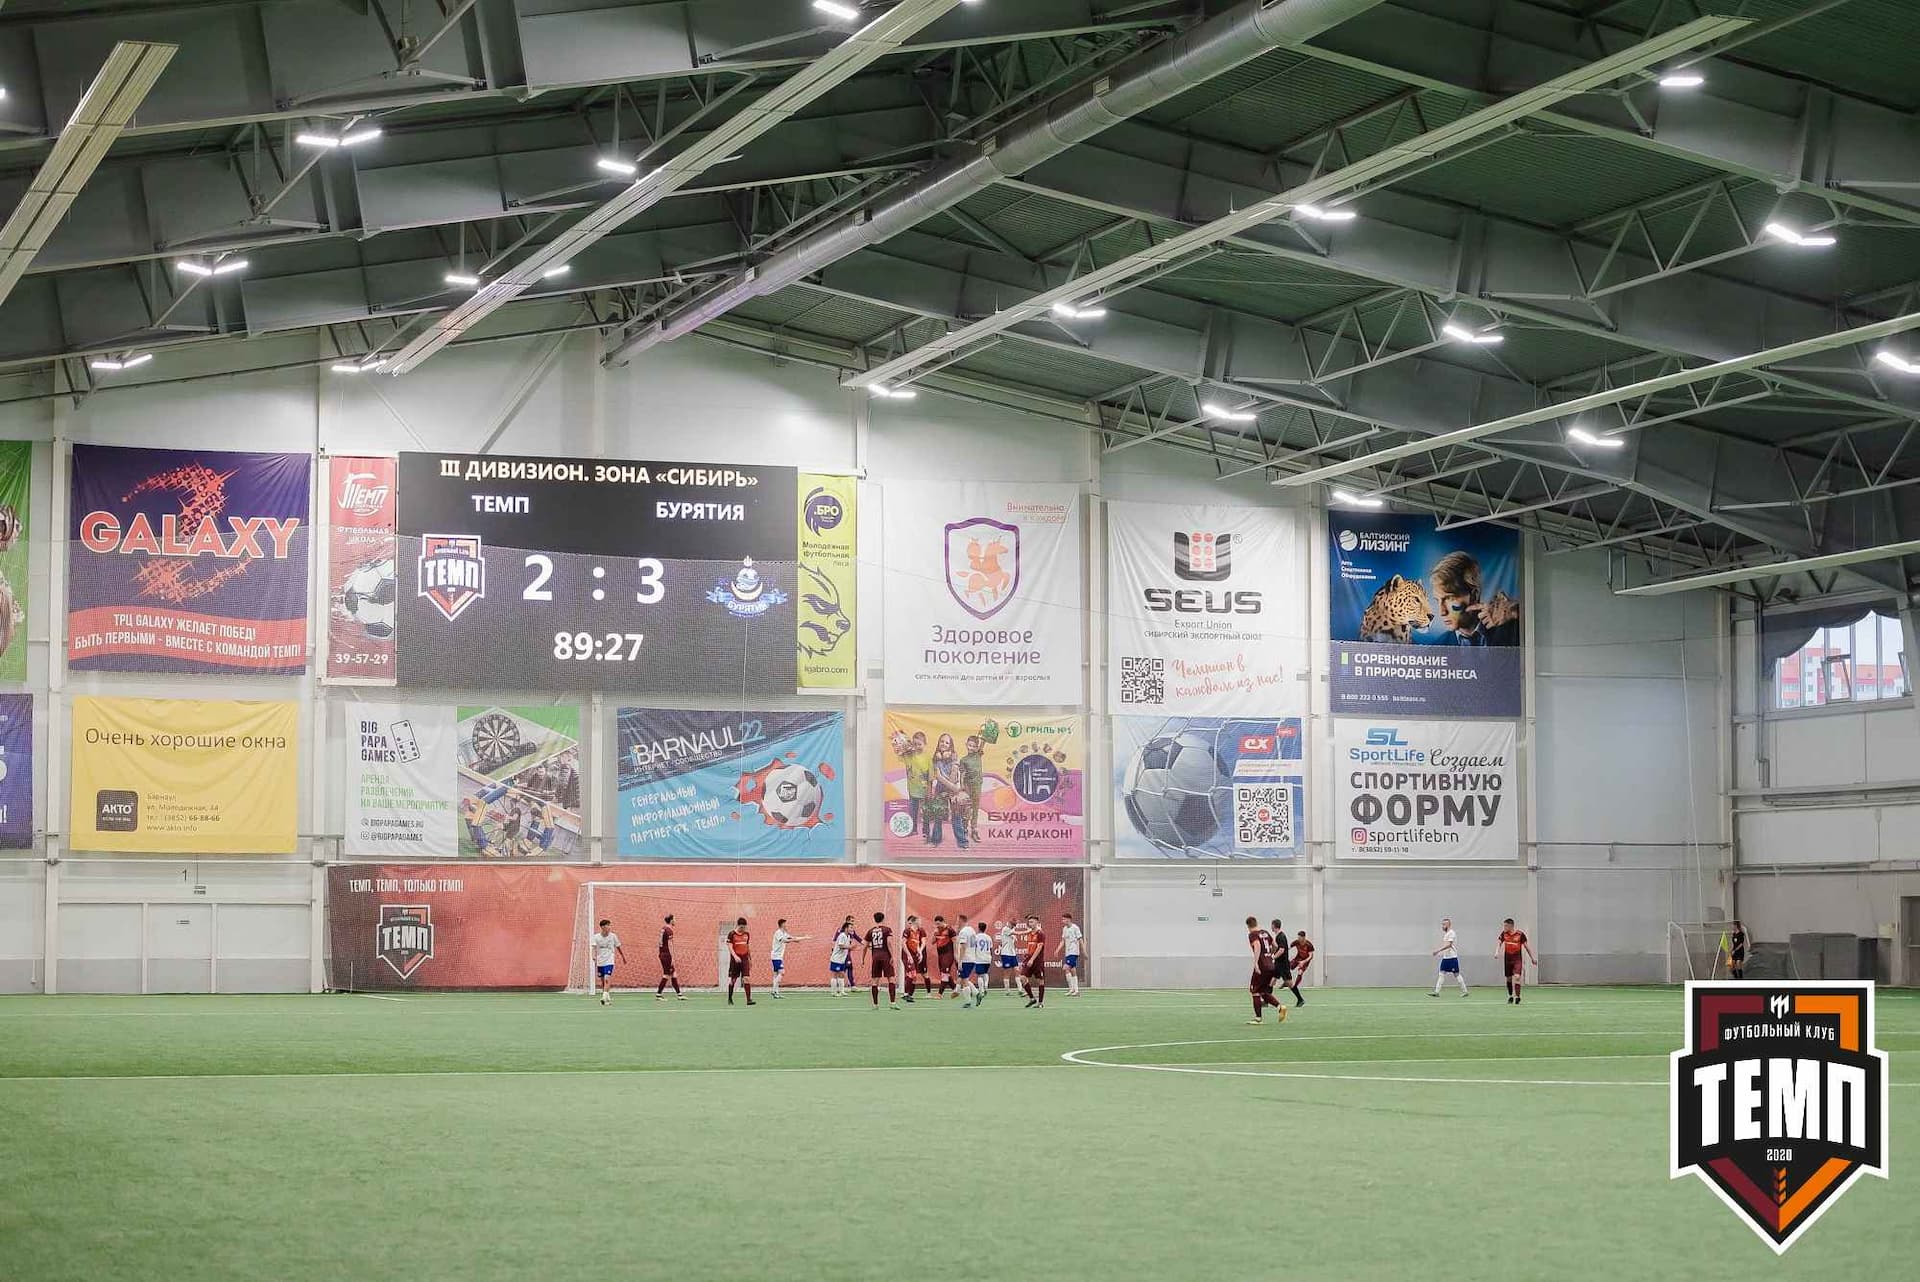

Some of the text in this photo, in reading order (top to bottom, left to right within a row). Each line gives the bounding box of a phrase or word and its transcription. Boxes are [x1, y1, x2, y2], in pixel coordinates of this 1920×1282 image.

[465, 461, 589, 482] ДИВИЗИОН.
[594, 466, 650, 484] ЗОНА
[655, 468, 758, 488] «СИБИРЬ»
[472, 494, 529, 513] ТЕМП
[655, 501, 744, 521] БУРЯТИЯ
[80, 510, 300, 559] GALAXY
[1359, 531, 1410, 541] БАЛТИЙСКИЙ
[1359, 540, 1410, 552] ЛИЗИНГ
[425, 559, 479, 588] ТЕМП
[522, 555, 553, 600] 2
[636, 558, 665, 604] 3
[1143, 588, 1263, 615] SEUS
[113, 613, 133, 626] ТРЦ
[136, 614, 174, 629] GALAXY
[176, 618, 217, 636] ЖЕЛАЕТ
[1174, 619, 1233, 630] Export Union
[931, 625, 1033, 645] Здоровое
[74, 633, 103, 650] БЫТЬ
[105, 631, 156, 645] ПЕРВЫМИ
[165, 634, 205, 653] ВМЕСТЕ
[215, 642, 270, 659] КОМАНДОЙ
[553, 631, 644, 662] 89:27
[335, 653, 389, 665] 39-57-29
[924, 649, 1041, 665] поколение
[1354, 653, 1448, 667] СОРЕВНОВАНИЕ
[1354, 666, 1478, 681] В ПРИРОДЕ БИЗНЕСА
[361, 720, 378, 734] BIG
[85, 727, 287, 752] Очень хорошие окна
[361, 735, 388, 749] PAPA
[361, 749, 396, 763] GAMES
[1349, 747, 1426, 763] SportLife
[1350, 771, 1503, 791] СПОРТИВНУЮ
[1350, 793, 1502, 827] ФОРМУ
[987, 828, 1073, 841] КАК ДРАКОН!
[1368, 828, 1460, 845] sportlifebrn
[182, 868, 188, 882] 1
[1199, 873, 1207, 886] 2
[350, 879, 464, 893] ТЕМП, ТЕМП, ТОЛЬКО ТЕМП!
[382, 925, 428, 951] ТЕМП
[871, 931, 884, 945] 22
